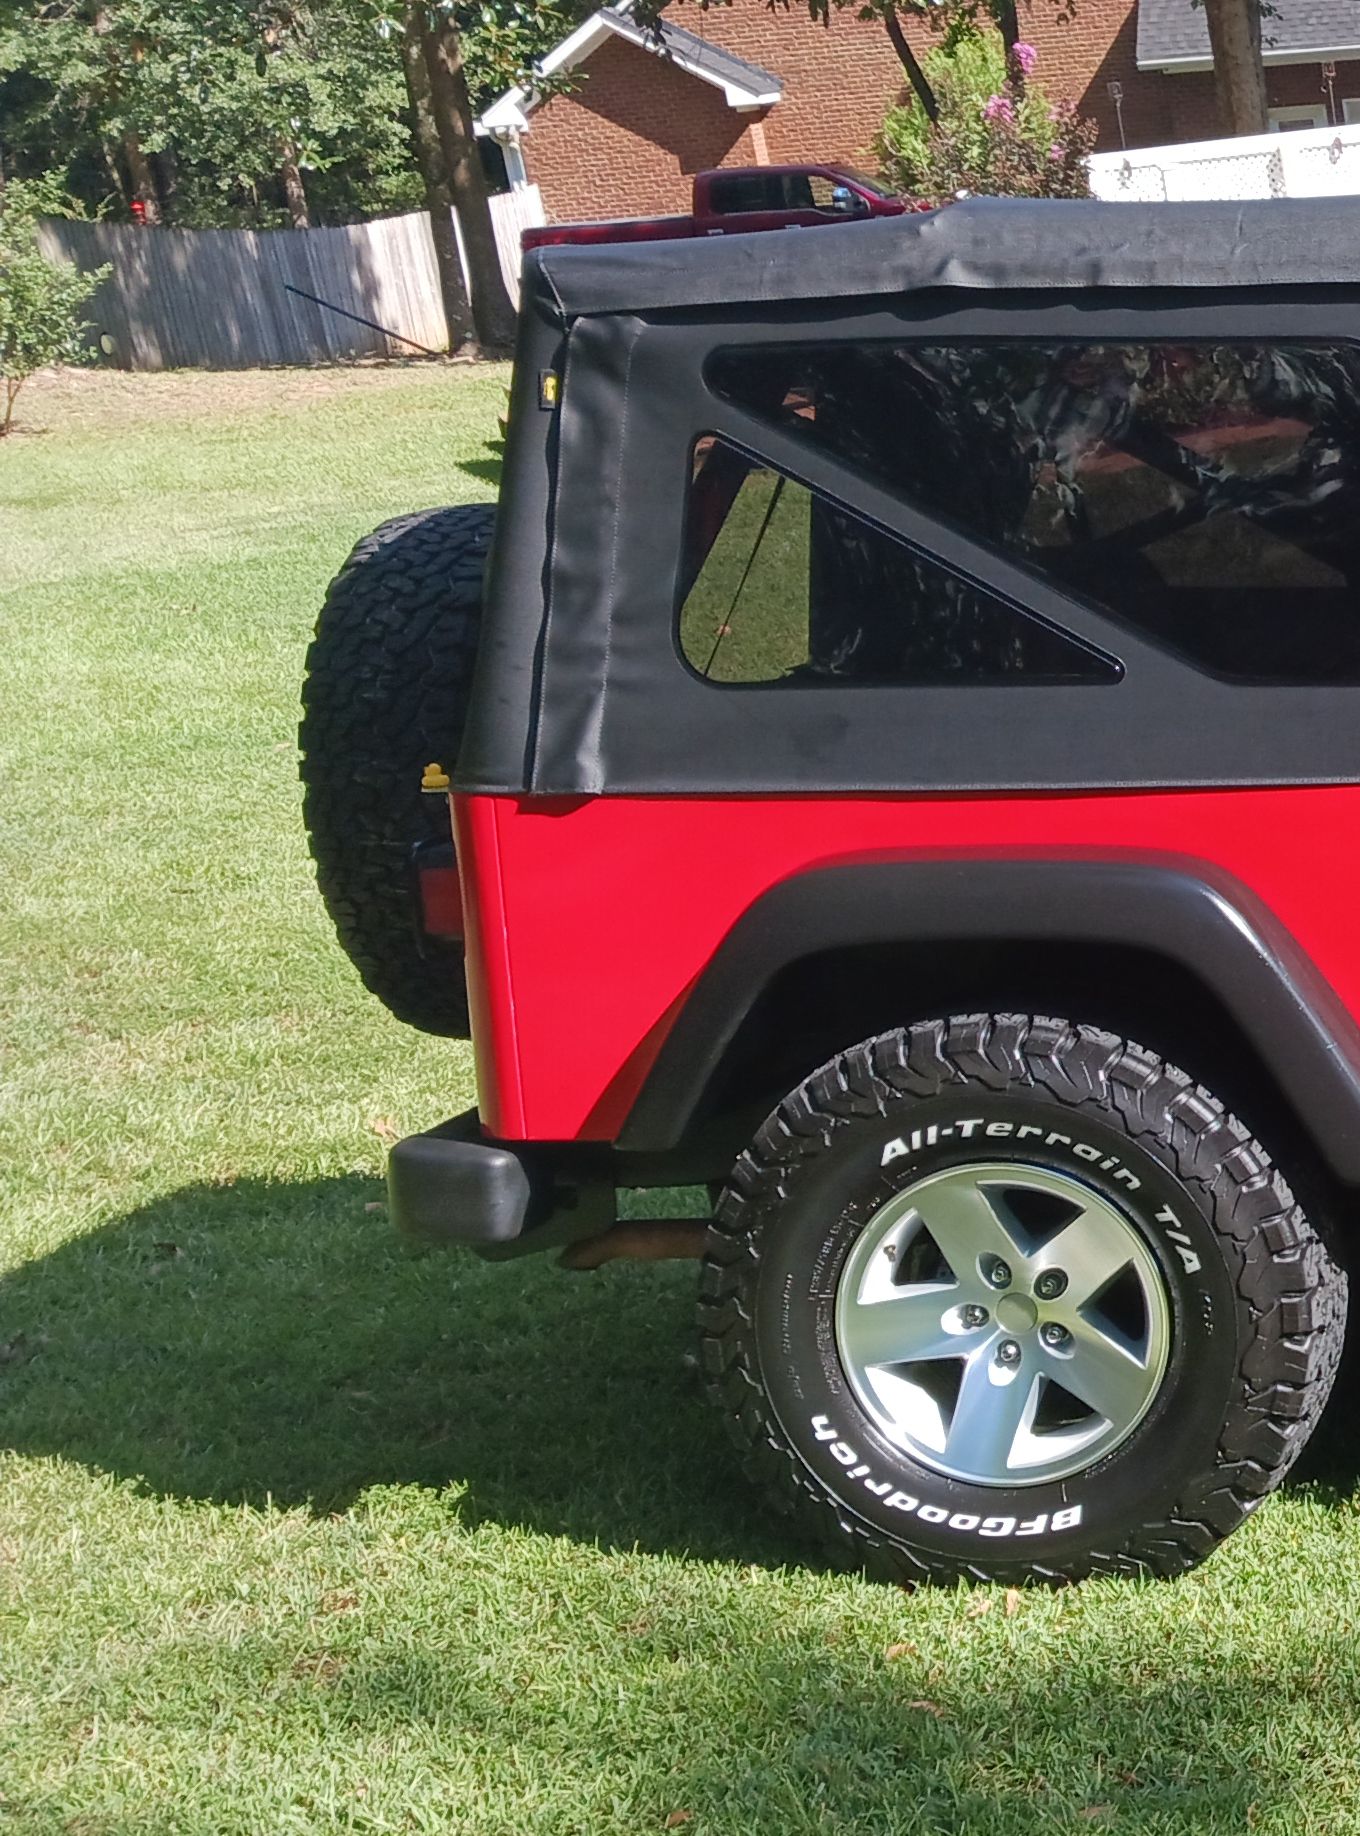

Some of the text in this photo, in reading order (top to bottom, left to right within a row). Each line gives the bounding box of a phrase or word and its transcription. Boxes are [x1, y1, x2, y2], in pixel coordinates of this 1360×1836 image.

[880, 1117, 1203, 1277] All-Terrain T/A
[809, 1413, 1084, 1537] BFGoodrich
